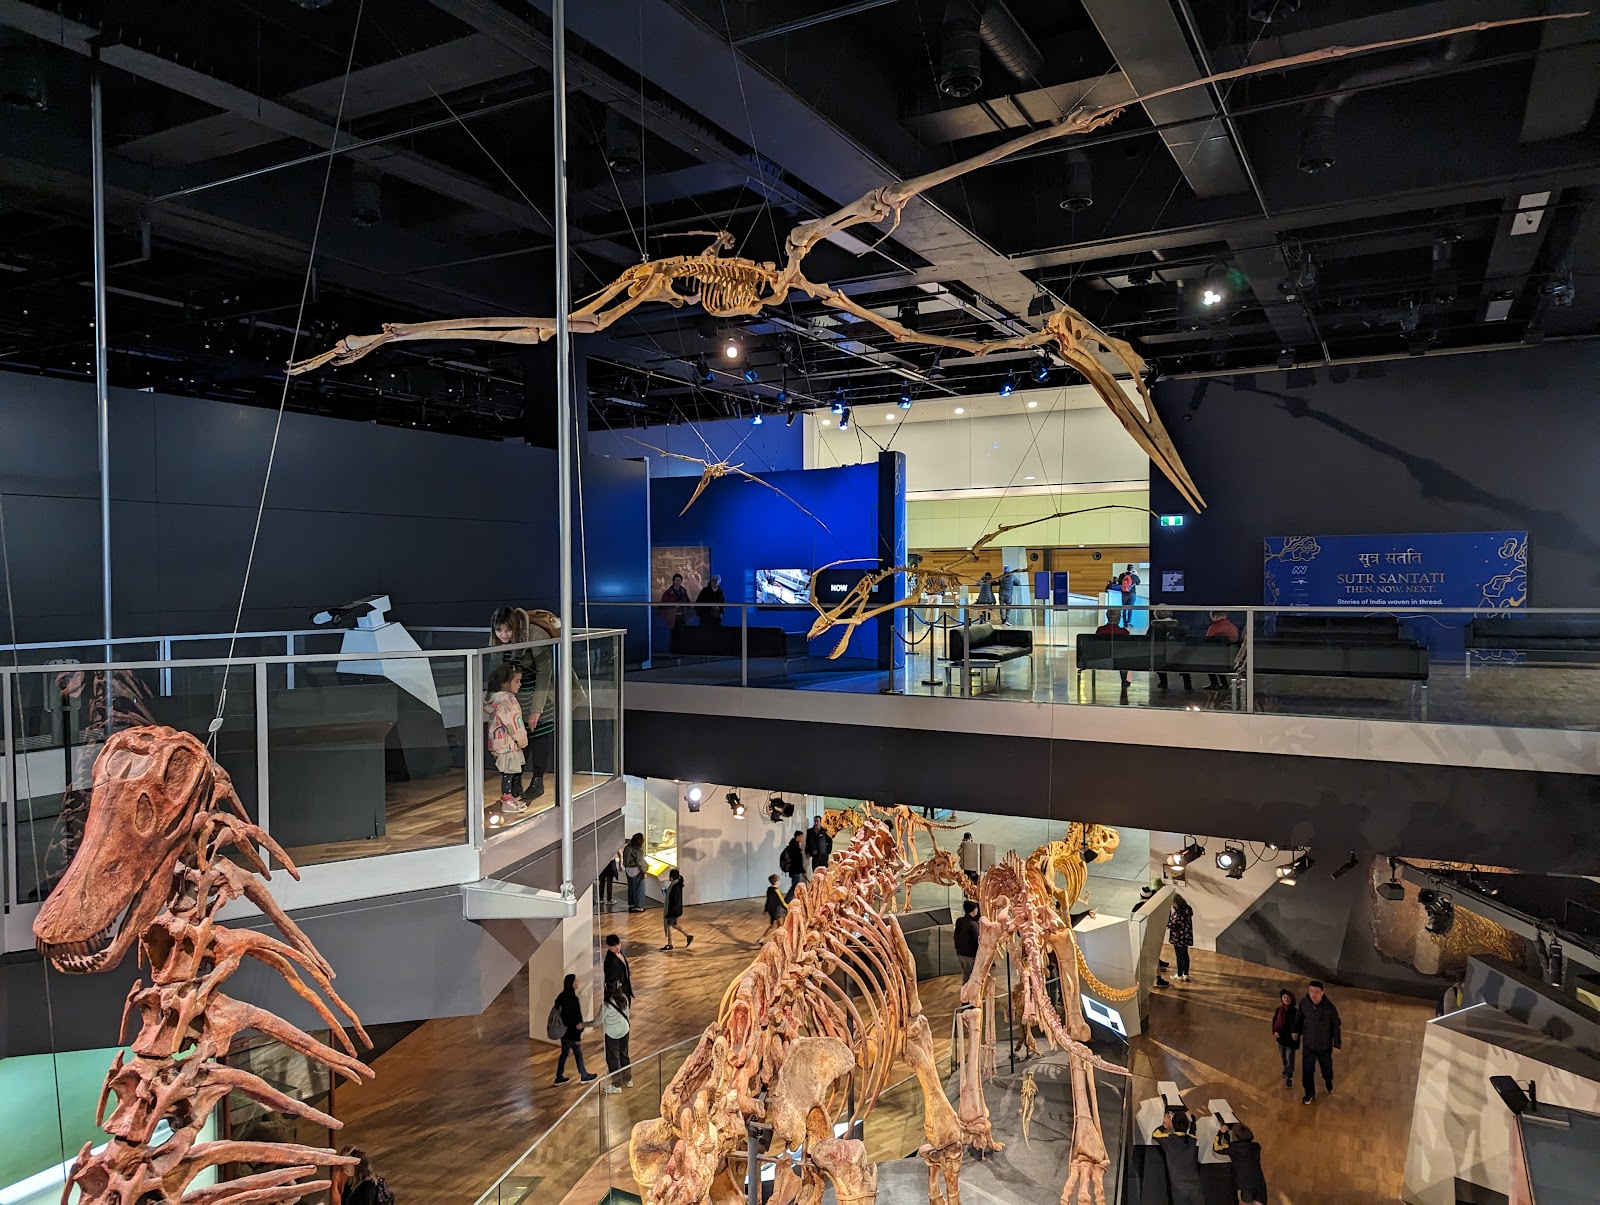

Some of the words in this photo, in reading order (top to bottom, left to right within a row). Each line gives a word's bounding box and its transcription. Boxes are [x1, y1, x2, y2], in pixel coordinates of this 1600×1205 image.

[1358, 553, 1380, 568] सूत्र
[1337, 573, 1376, 584] SUTR
[1379, 572, 1445, 584] SANTATI
[830, 584, 849, 592] NOW
[1345, 585, 1376, 593] THEN.
